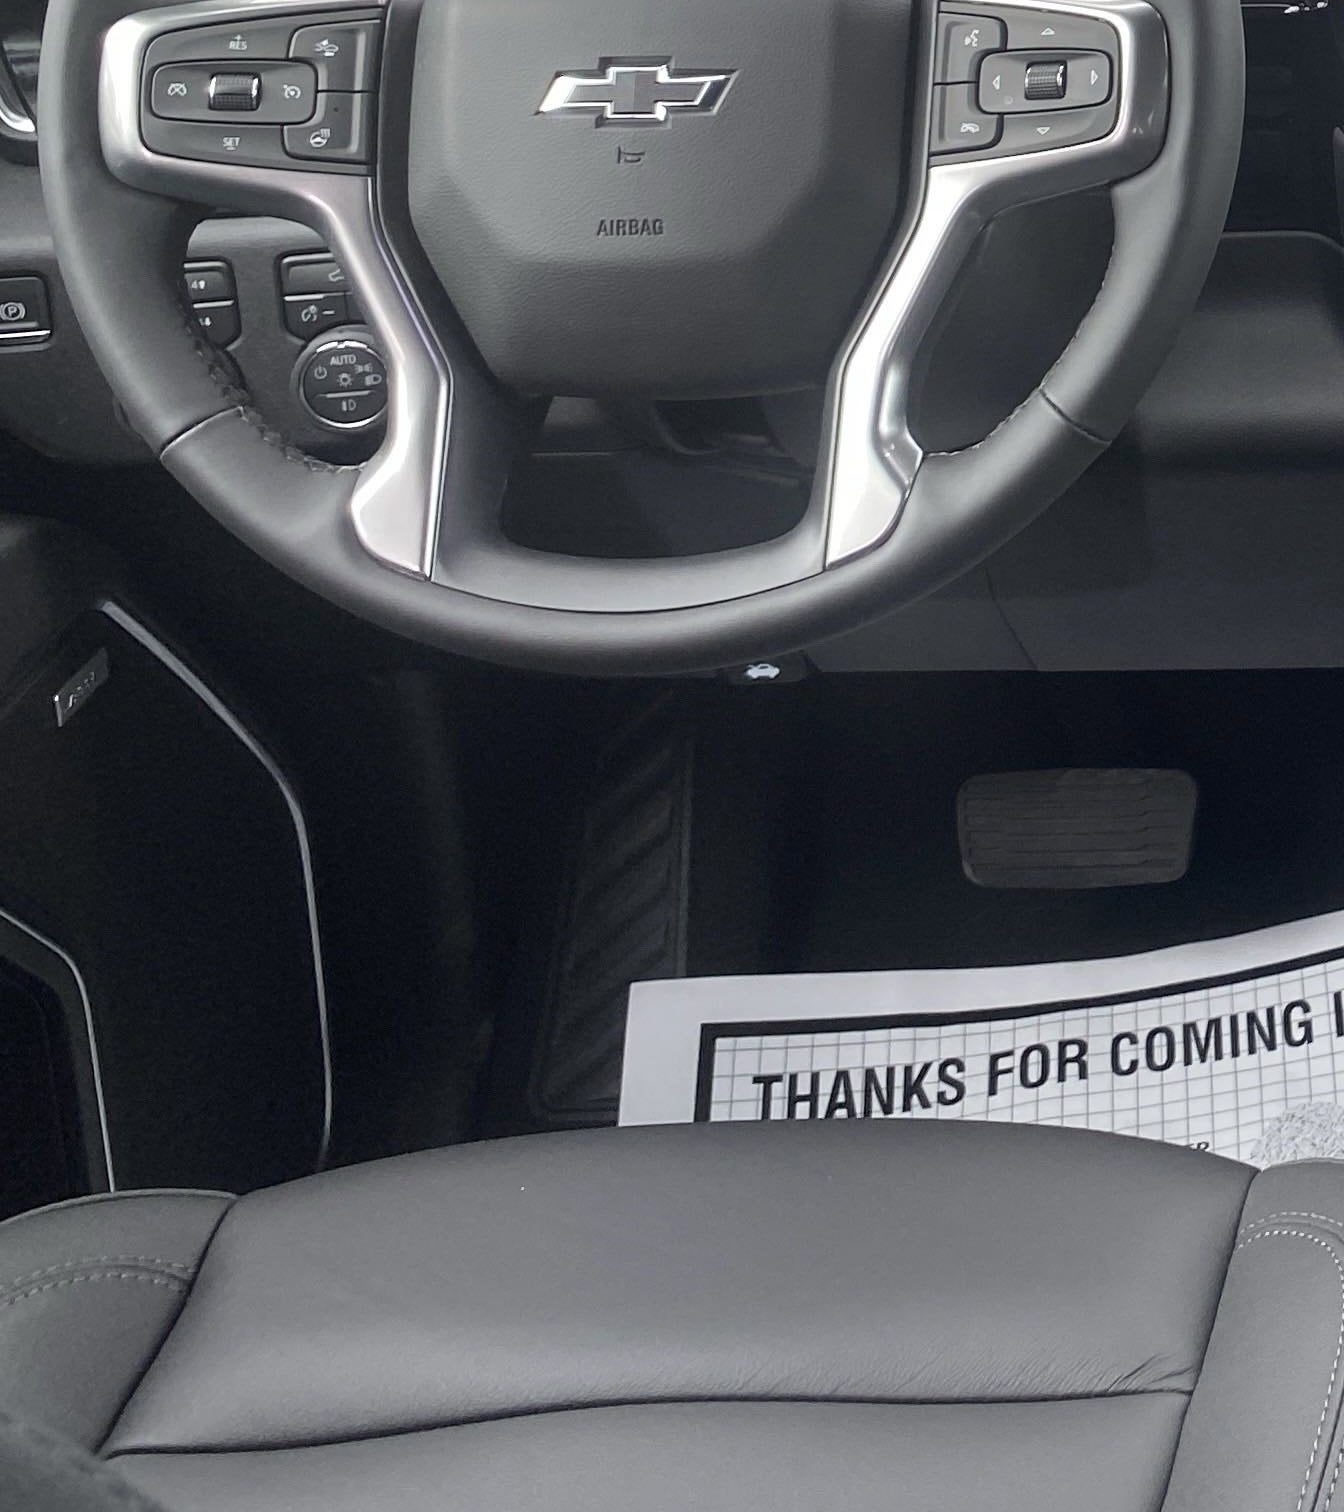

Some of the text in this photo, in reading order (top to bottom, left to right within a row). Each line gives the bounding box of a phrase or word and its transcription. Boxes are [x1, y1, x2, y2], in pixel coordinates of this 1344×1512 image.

[229, 41, 247, 49] RES
[223, 137, 240, 146] SET
[597, 218, 664, 236] AIRBAG
[330, 355, 356, 365] AUTO
[752, 1057, 967, 1120] THANKS
[986, 1037, 1089, 1097] FOR
[1110, 998, 1315, 1073] COMING
